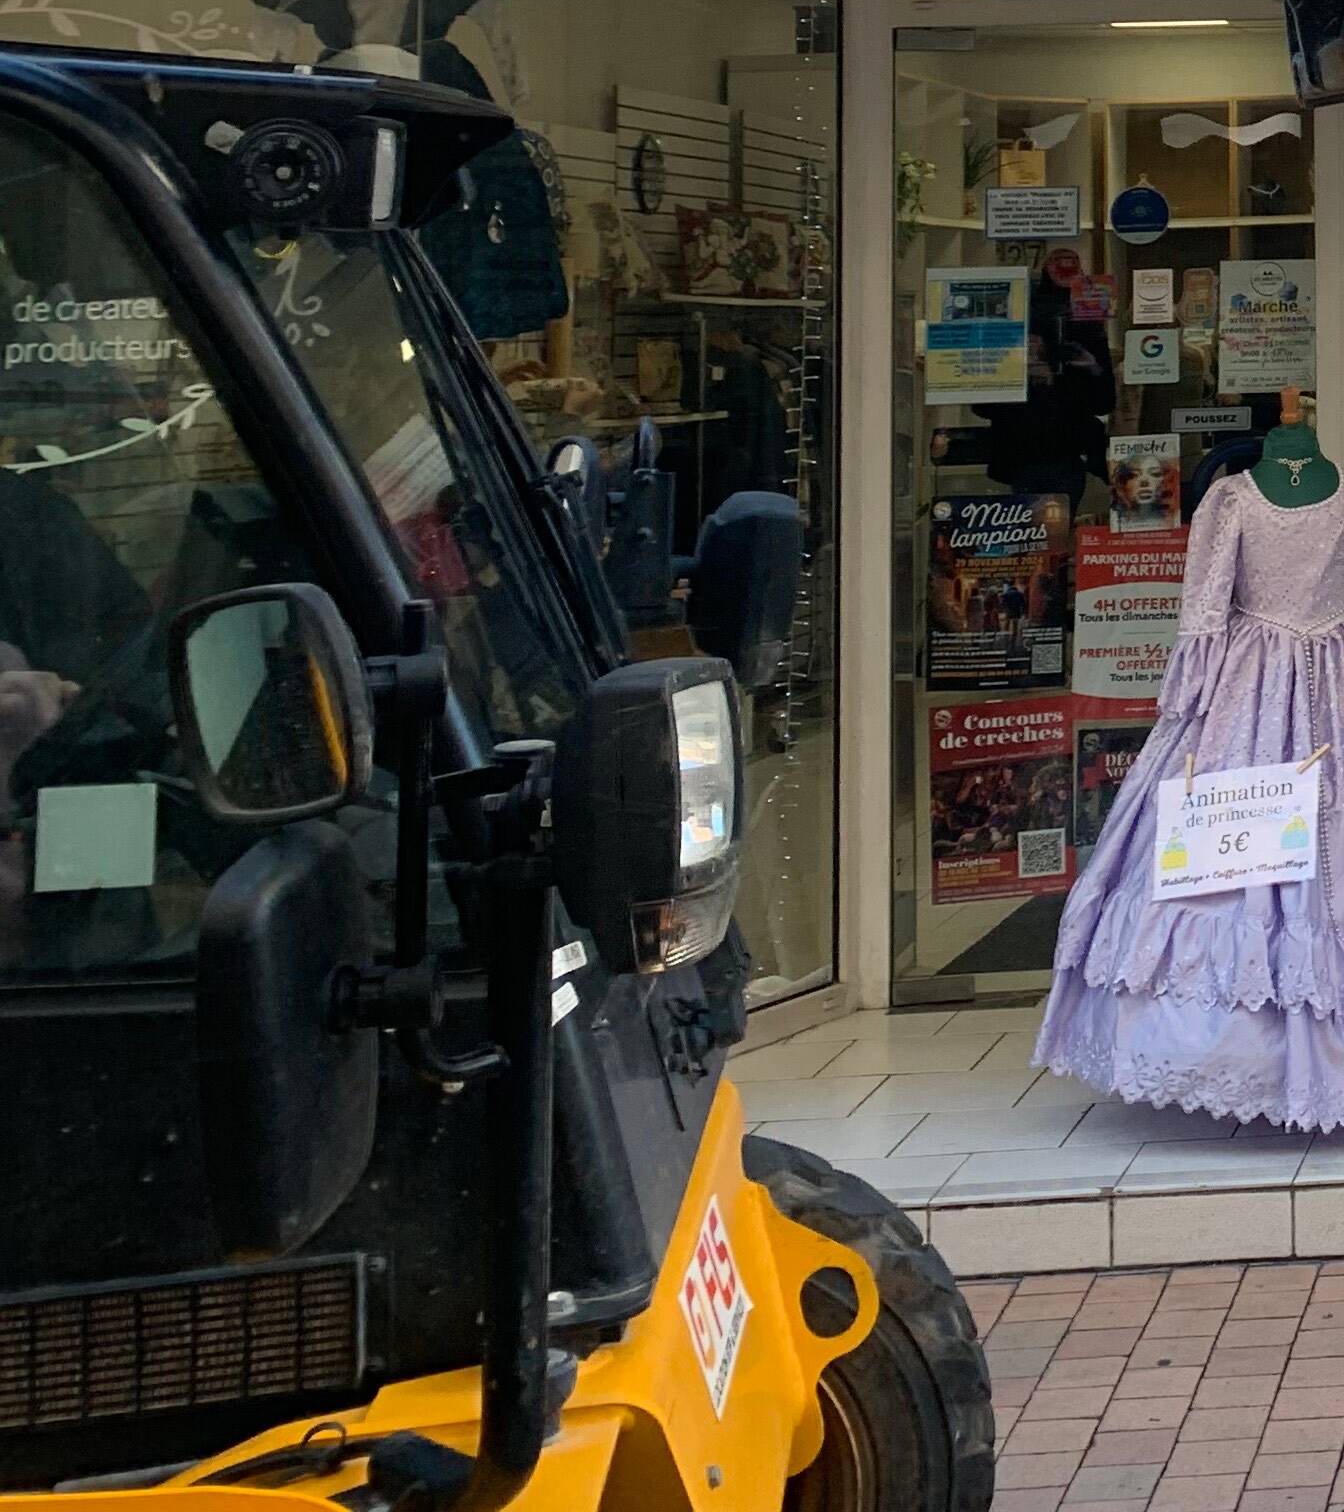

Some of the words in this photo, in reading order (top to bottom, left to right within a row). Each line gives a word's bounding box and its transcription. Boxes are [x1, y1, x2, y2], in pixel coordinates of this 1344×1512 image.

[13, 295, 51, 323] de
[1184, 413, 1238, 425] POUSSEZ
[961, 503, 1033, 528] Mille
[950, 523, 1048, 552] lampions
[1082, 554, 1139, 566] PARKING
[1142, 553, 1159, 563] DU
[1093, 599, 1117, 612] 4H
[1120, 596, 1183, 611] OFFERT
[1079, 613, 1104, 623] Tous
[1106, 611, 1120, 622] les
[1122, 610, 1178, 621] dimanches
[1110, 673, 1133, 682] Tous
[1135, 672, 1149, 681] les
[964, 710, 1064, 731] Concours
[939, 732, 968, 750] de
[974, 725, 1064, 747] crèches
[1181, 779, 1293, 811] Animation
[1186, 813, 1203, 828] de
[1208, 805, 1283, 828] princesse
[1218, 831, 1251, 855] 5€
